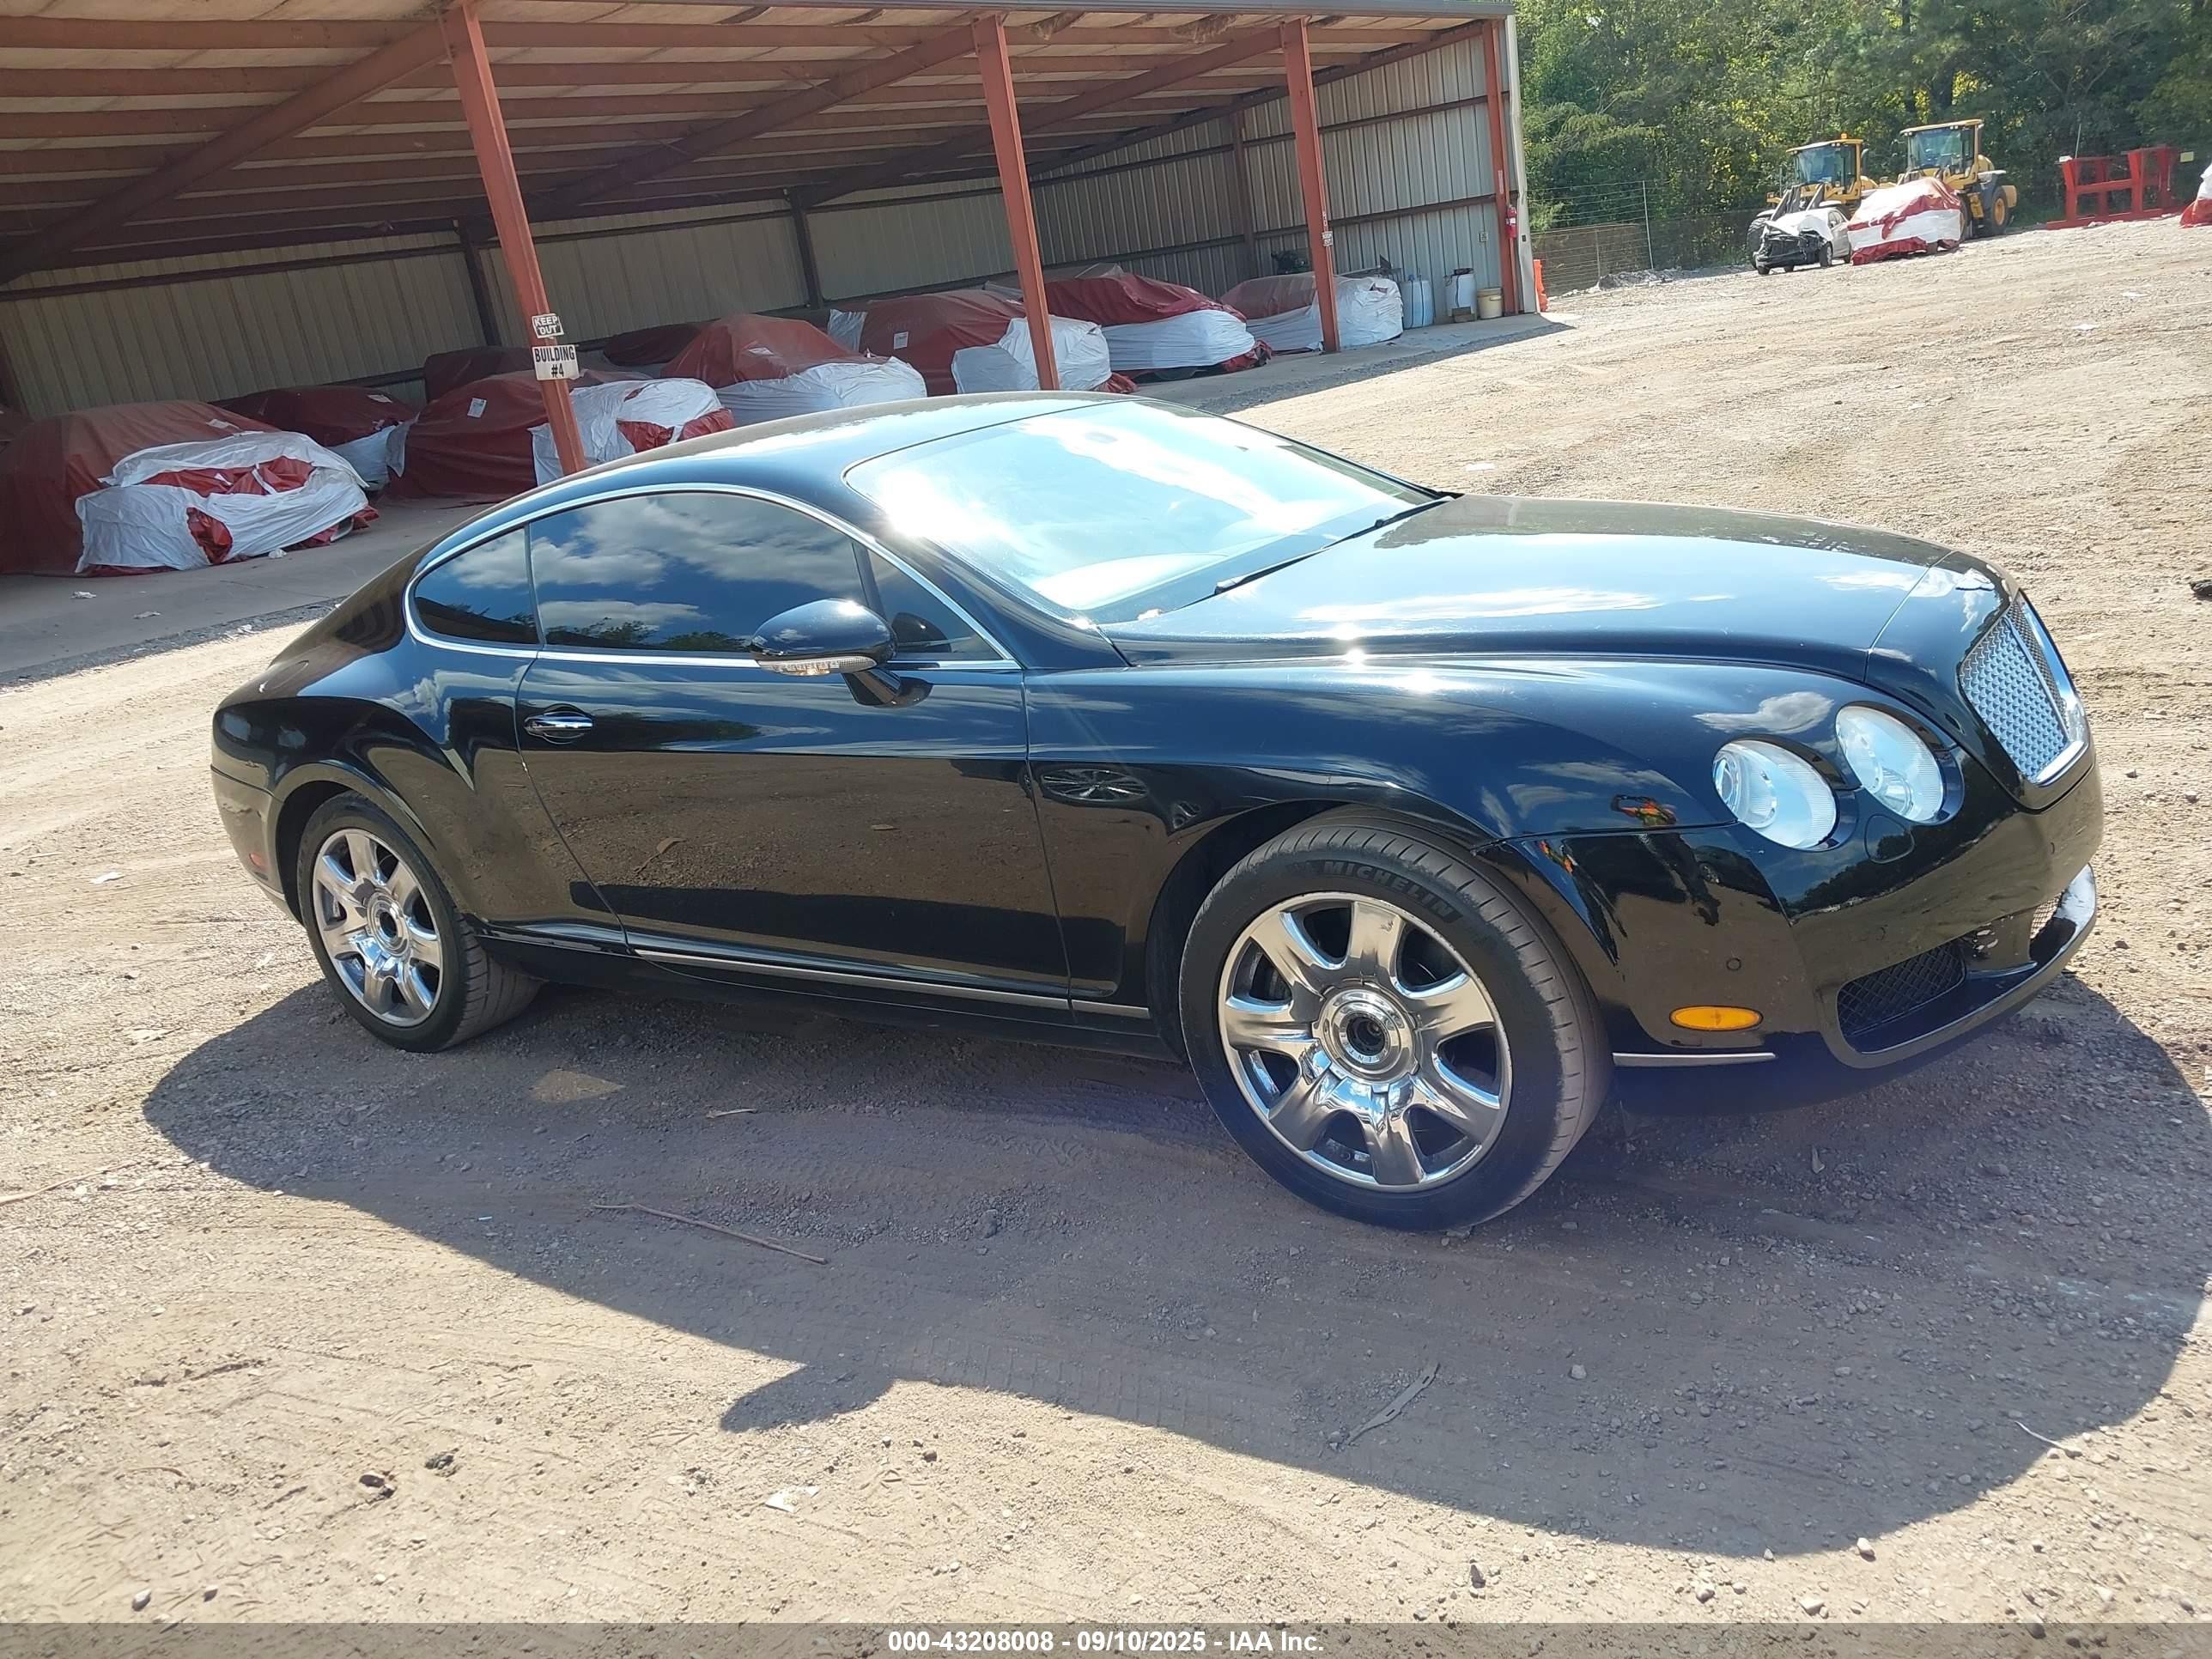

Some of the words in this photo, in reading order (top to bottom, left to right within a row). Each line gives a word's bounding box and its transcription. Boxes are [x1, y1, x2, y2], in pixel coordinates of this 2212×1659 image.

[534, 316, 558, 326] KEEP
[539, 325, 557, 335] OUT
[535, 346, 575, 362] BUILDING
[551, 363, 564, 378] #4
[1323, 860, 1455, 918] MICHELIN
